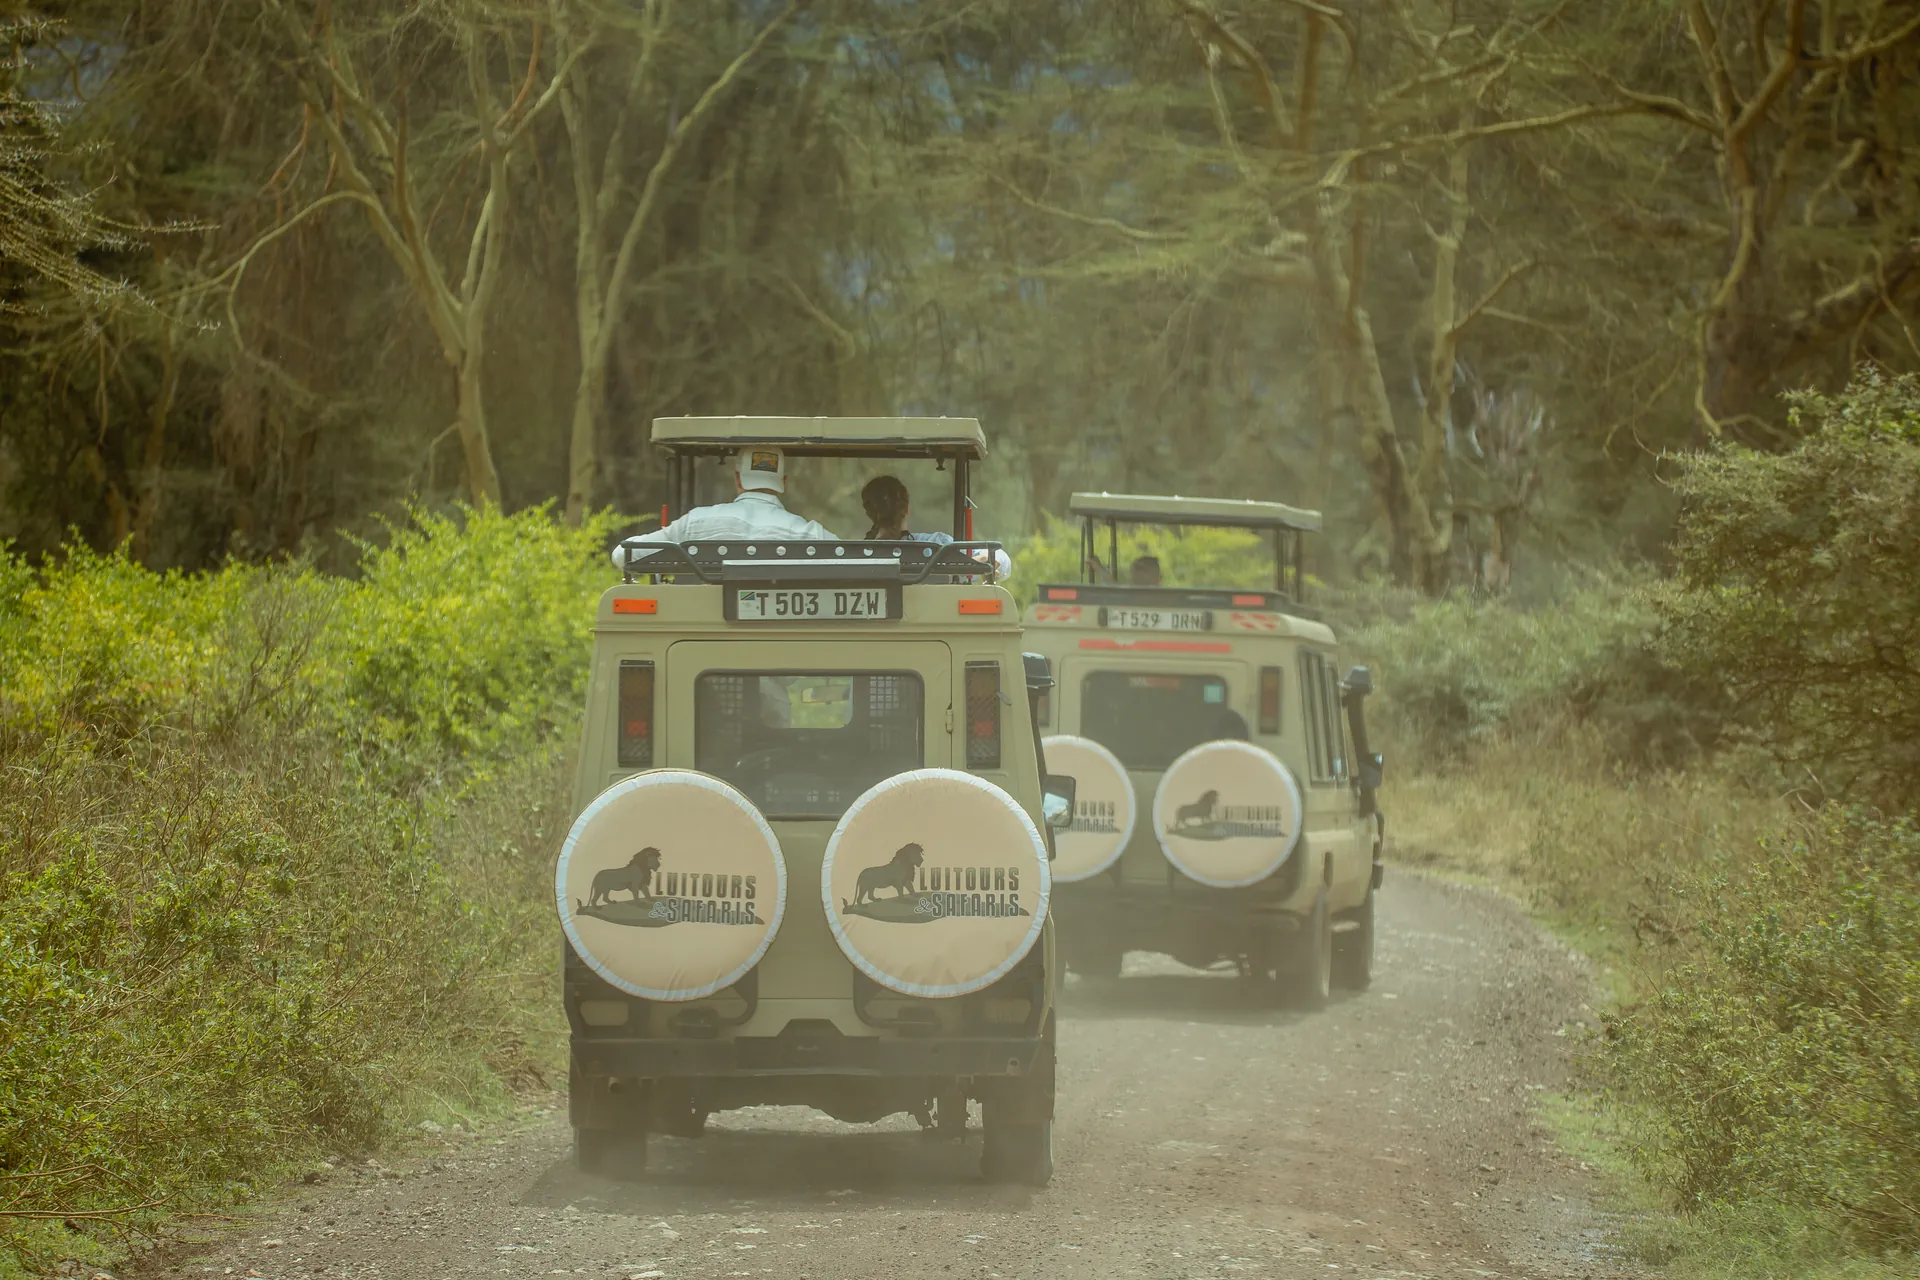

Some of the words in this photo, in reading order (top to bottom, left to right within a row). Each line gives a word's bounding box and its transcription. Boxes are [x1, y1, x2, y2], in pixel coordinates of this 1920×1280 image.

[756, 592, 769, 616] T
[776, 592, 820, 616] 503
[834, 592, 879, 616] DZW
[1120, 611, 1127, 627] T
[1130, 611, 1160, 629] 529
[655, 872, 757, 899] LUITOURS
[919, 867, 1020, 891] LUITOURS
[649, 902, 666, 918] &
[666, 897, 756, 925] SAFARIS
[914, 897, 931, 914] &
[931, 893, 1021, 917] SAFARIS
